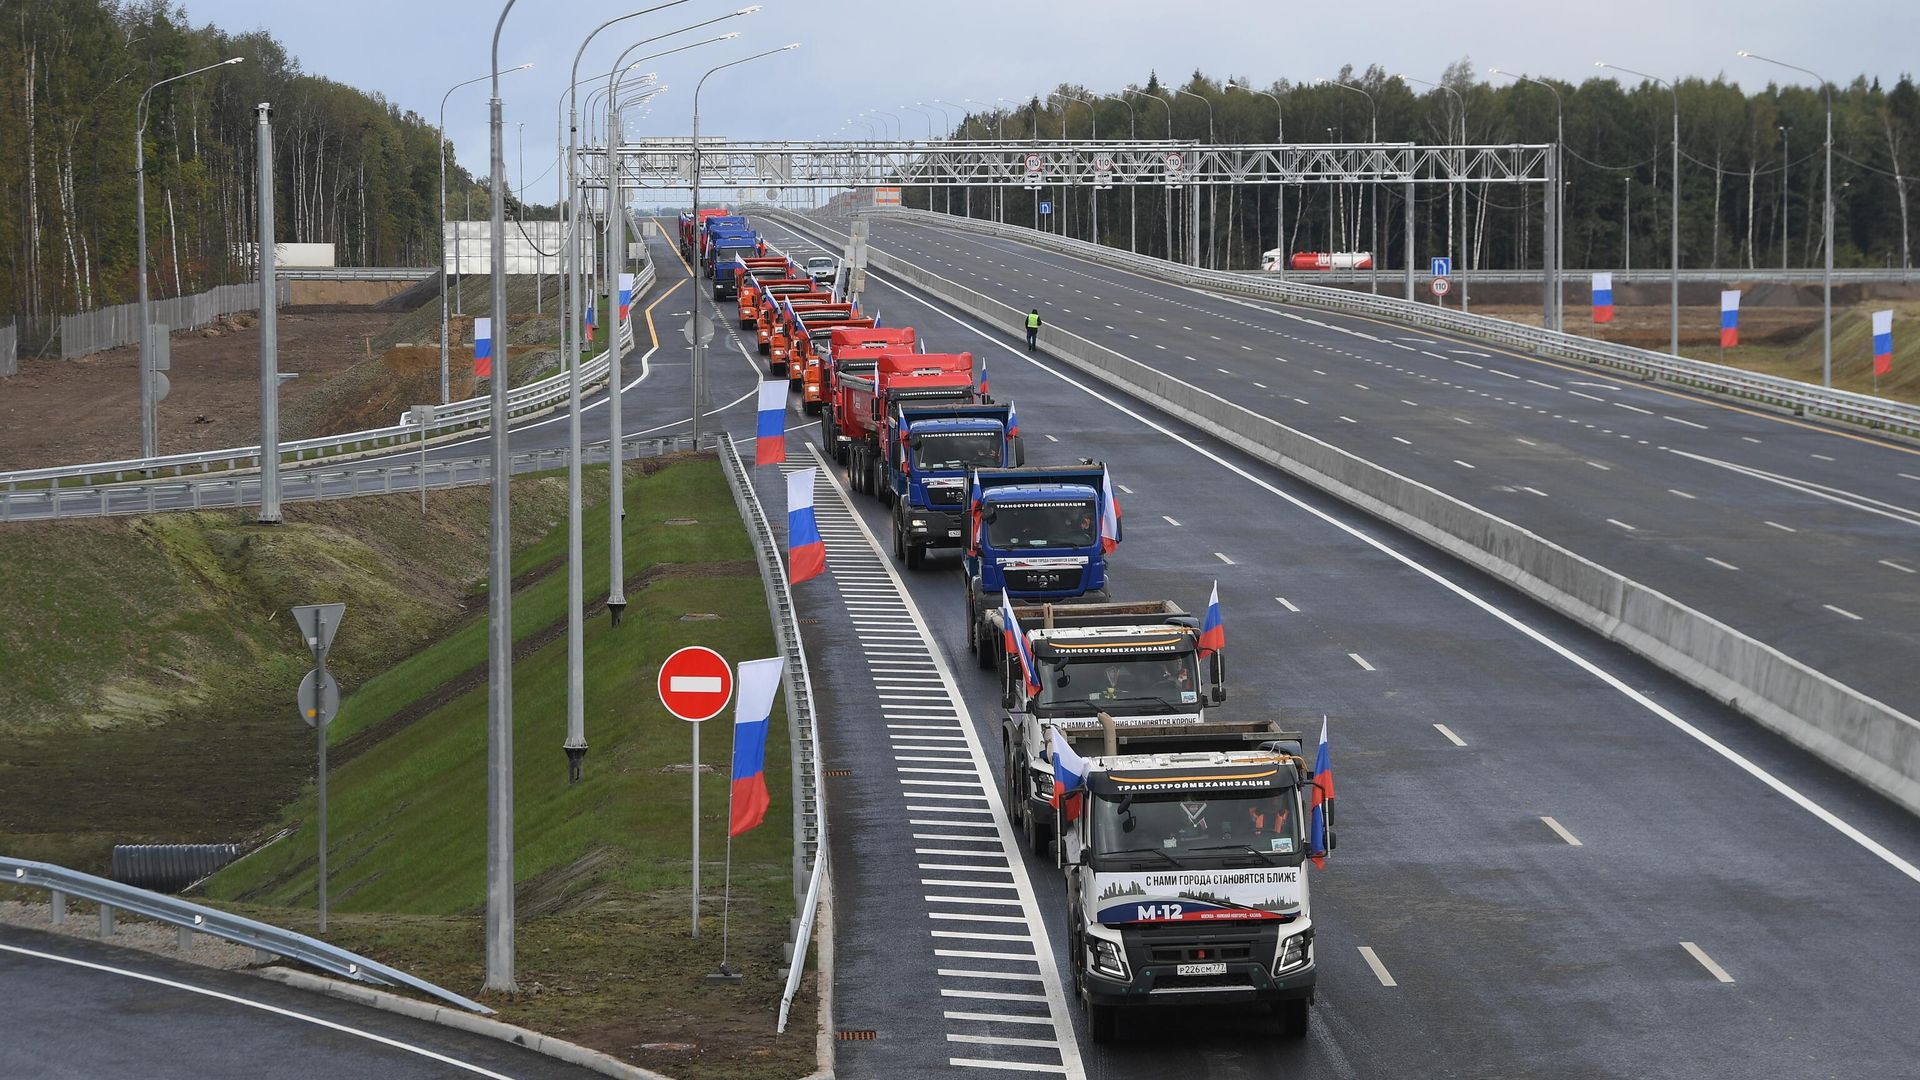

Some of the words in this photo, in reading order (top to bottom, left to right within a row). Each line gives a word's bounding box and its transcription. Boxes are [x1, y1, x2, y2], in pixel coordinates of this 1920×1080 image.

[1169, 158, 1180, 166] 110
[1435, 282, 1446, 290] 110
[1026, 574, 1059, 582] MAN
[1055, 646, 1176, 654] ТРАНССТРОЙМЕХАНИЗАЦИЯ
[1117, 780, 1271, 792] ТРАНССТРОЙМЕХАНИЗАЦИЯ
[1146, 875, 1152, 886] С
[1153, 875, 1178, 886] НАМИ
[1179, 874, 1212, 886] ГОРОДА
[1213, 873, 1265, 885] СТАНОВЯТСЯ
[1267, 872, 1297, 884] БЛИЖЕ
